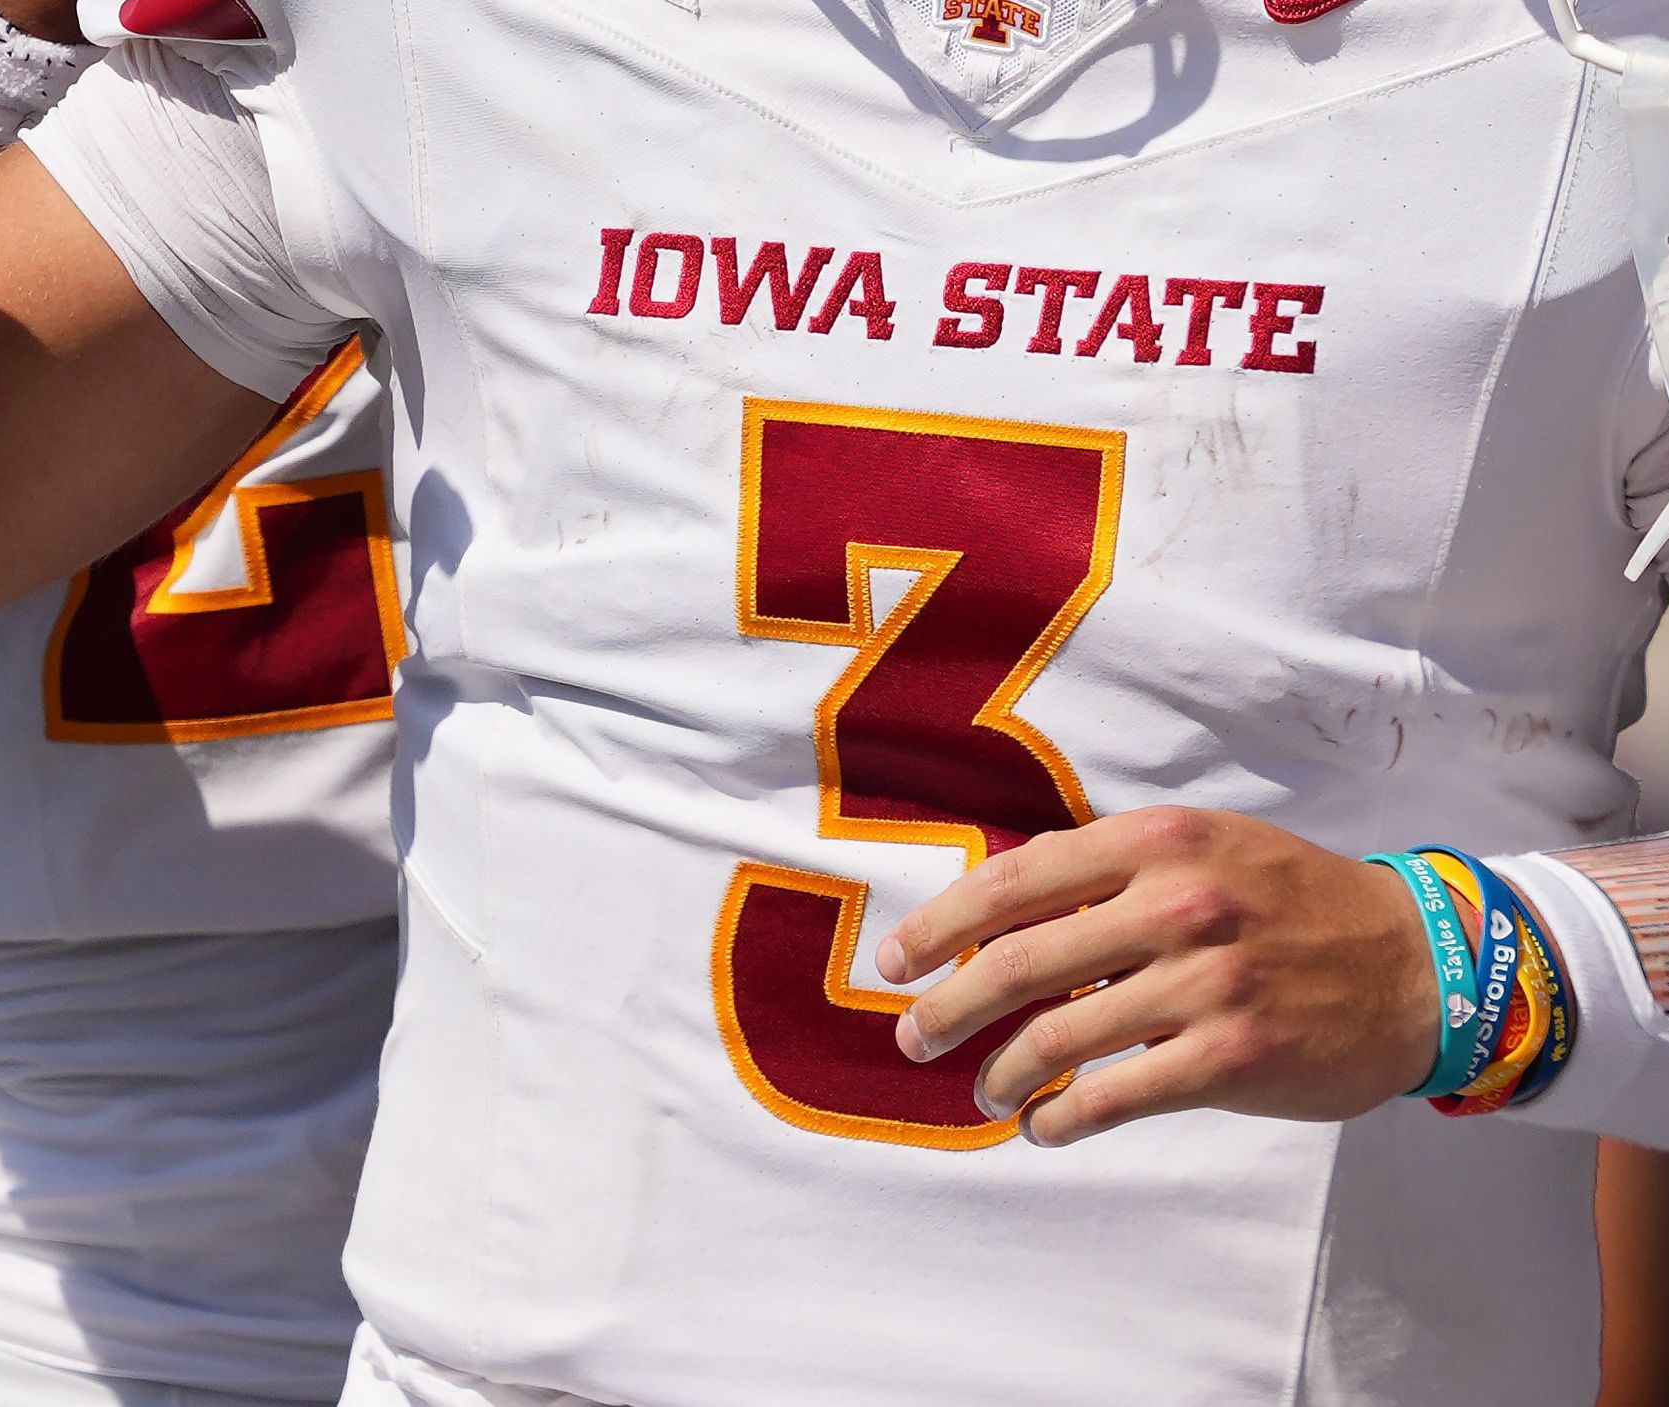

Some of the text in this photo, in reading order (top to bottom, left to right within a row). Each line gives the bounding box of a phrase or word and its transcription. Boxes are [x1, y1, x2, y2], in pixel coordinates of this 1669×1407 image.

[585, 227, 1327, 375] IOWA STATE
[710, 396, 1127, 1152] 3
[1404, 857, 1467, 982] Jaylee Strong
